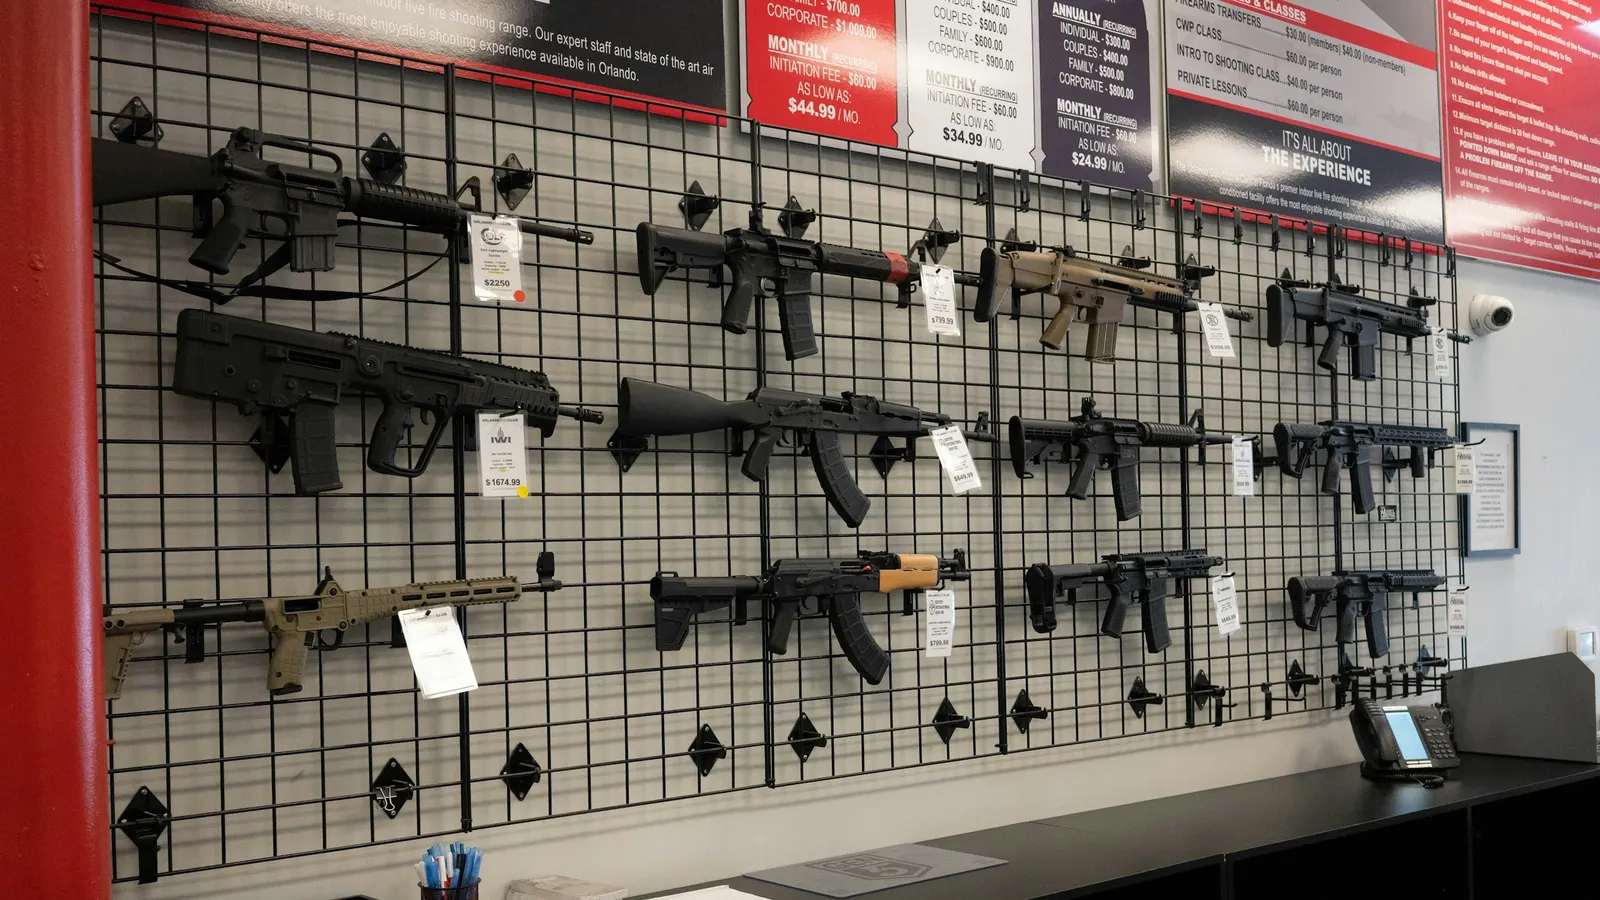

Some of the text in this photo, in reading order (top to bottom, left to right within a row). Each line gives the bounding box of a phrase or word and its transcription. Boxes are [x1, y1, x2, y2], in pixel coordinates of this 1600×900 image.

[767, 3, 828, 28] CORPORATE
[826, 0, 860, 17] $700.00
[933, 5, 973, 27] COUPLES
[979, 17, 1008, 36] $500.00
[982, 0, 1010, 19] $400.00
[1052, 2, 1101, 26] ANNUALLY
[1263, 1, 1307, 23] CLASSES
[276, 0, 311, 17] offers
[315, 4, 335, 21] the
[338, 11, 367, 28] most
[371, 17, 426, 39] enjoyable
[430, 28, 476, 51] shooting
[479, 39, 537, 61] experience
[540, 51, 584, 71] available
[587, 58, 596, 73] in
[598, 61, 640, 82] Orlando.
[405, 0, 425, 15] live
[428, 4, 446, 19] fire
[449, 10, 496, 32] shooting
[499, 21, 532, 39] range.
[535, 26, 554, 42] Our
[557, 34, 588, 50] expert
[590, 38, 611, 55] staff
[614, 44, 632, 59] and
[634, 49, 657, 65] state
[660, 52, 670, 67] of
[671, 55, 686, 70] the
[688, 60, 700, 73] art
[702, 63, 714, 76] air
[768, 34, 828, 60] MONTHLY
[939, 25, 1003, 52] FAMILY $600.00
[1060, 22, 1130, 51] INDIVIDUAL $300.00
[1176, 17, 1194, 34] CWP
[1286, 50, 1307, 67] $60.00
[1308, 58, 1319, 72] per
[1320, 60, 1342, 77] person
[928, 40, 1015, 72] CORPORATE $900.00
[1063, 39, 1128, 66] COUPLES $400.00
[1286, 26, 1306, 44] $30.00
[1307, 32, 1342, 56] (members)
[1342, 44, 1361, 60] $40.00
[1363, 49, 1406, 76] (non-members)
[770, 55, 877, 90] INITIATION FEE $60.00
[926, 69, 977, 93] MONTHLY
[1068, 57, 1124, 82] FAMILY $500.00
[1177, 43, 1201, 61] INTRO
[1203, 48, 1213, 64] TO
[1215, 53, 1255, 76] SHOOTING
[1309, 82, 1320, 96] per
[1321, 84, 1343, 101] person
[797, 81, 852, 104] AS LOW AS:
[1059, 72, 1134, 100] CORPORATE $800.00
[1177, 69, 1210, 90] PRIVATE
[1287, 98, 1309, 115] $60.00
[1310, 106, 1321, 120] per
[1321, 108, 1344, 125] person
[788, 97, 836, 120] $44.99
[843, 110, 861, 125] MO.
[927, 88, 1018, 119] INITIATION FEE $60.00
[1057, 98, 1101, 120] MONTHLY
[950, 112, 997, 132] AS LOW AS:
[1058, 117, 1137, 144] INITIATION FEE $60.00
[943, 126, 983, 147] $34.99
[989, 138, 1004, 152] MO.
[1078, 138, 1119, 157] AS LOW AS:
[1282, 130, 1352, 161] IT'S ALL ABOUT
[1459, 139, 1483, 153] POINTED
[1483, 145, 1499, 158] DOWN
[1072, 151, 1107, 171] $24.99
[1112, 161, 1126, 174] MO.
[1261, 145, 1289, 168] THE
[1292, 153, 1371, 186] EXPERIENCE
[1465, 153, 1490, 167] PROBLEM
[1219, 186, 1249, 199] conditioned
[1249, 192, 1266, 204] facility
[1265, 195, 1280, 206] offers
[1280, 197, 1289, 207] the
[1288, 199, 1301, 210] most
[1301, 202, 1323, 215] enjoyable
[1323, 206, 1342, 220] shooting
[1298, 186, 1314, 197] indoor
[1331, 193, 1350, 207] shooting
[484, 279, 510, 287] $2250
